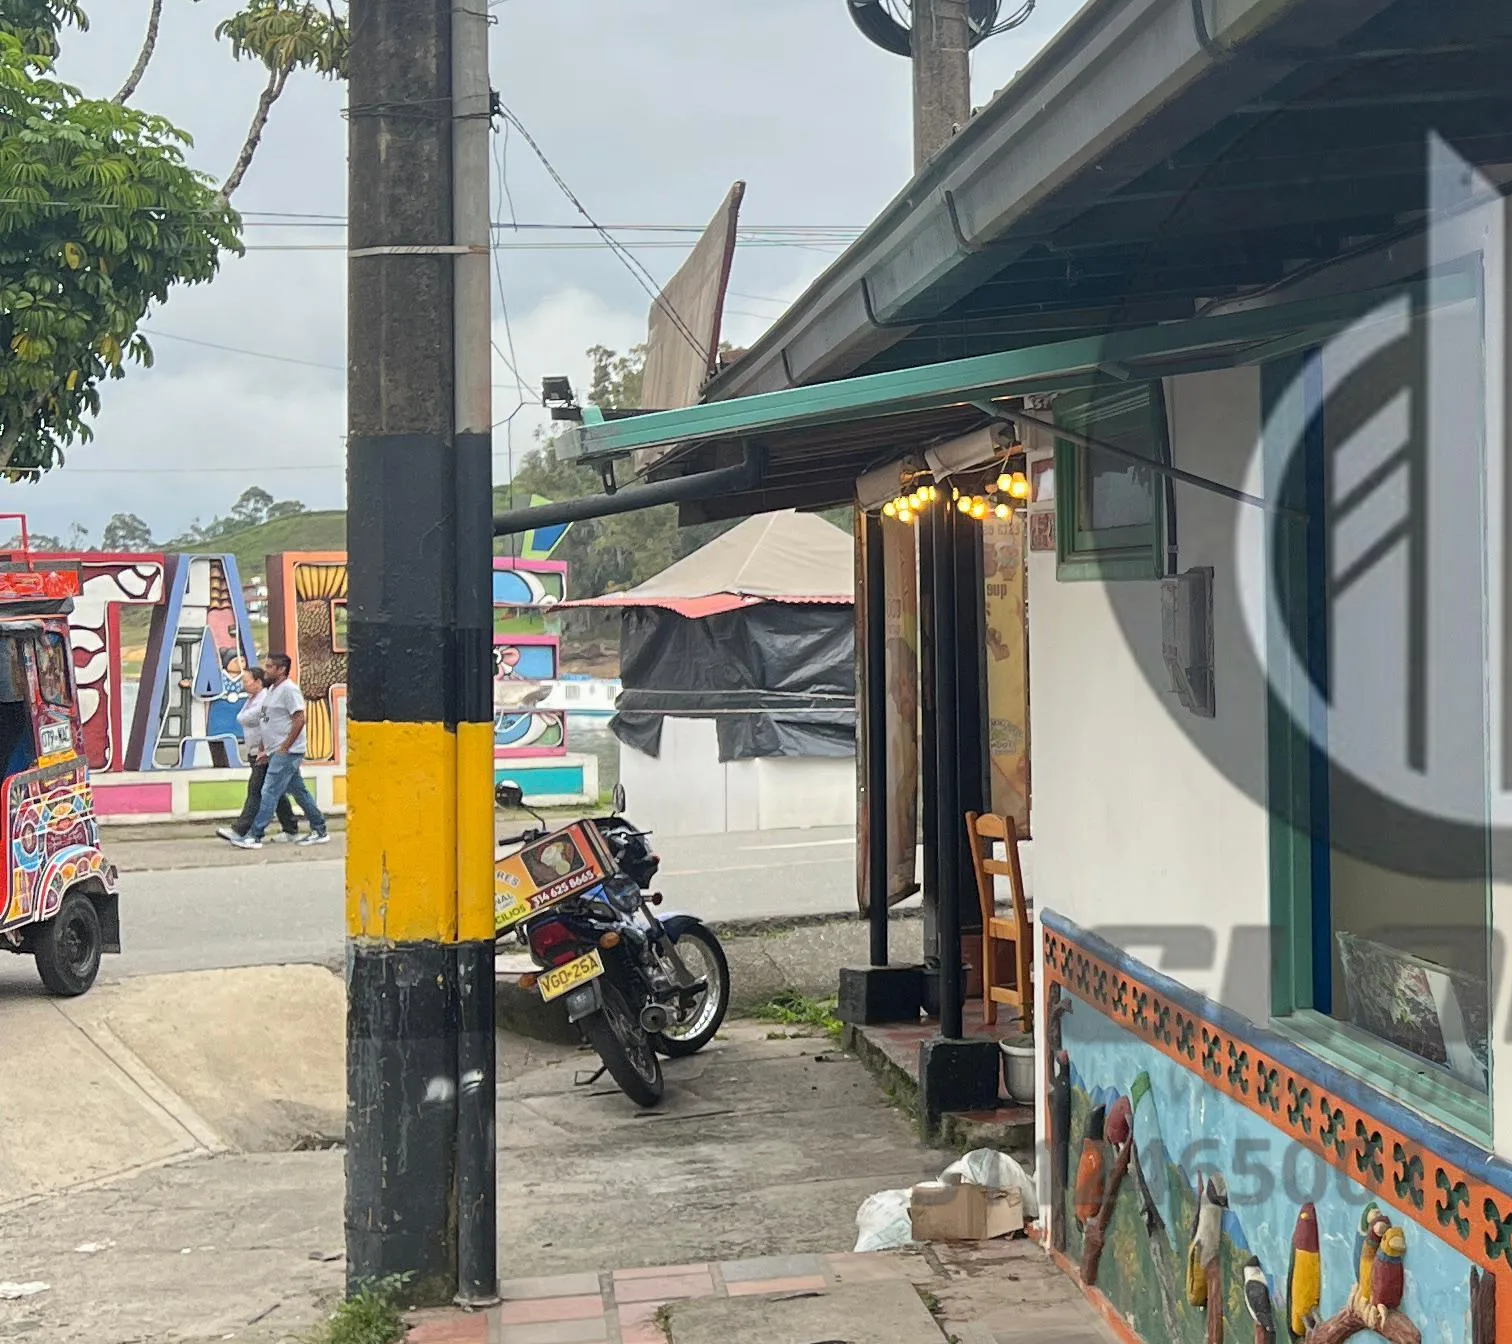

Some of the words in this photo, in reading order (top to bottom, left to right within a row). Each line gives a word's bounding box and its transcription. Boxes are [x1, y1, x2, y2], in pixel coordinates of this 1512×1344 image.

[531, 891, 550, 908] 314
[550, 881, 569, 897] 625
[568, 869, 594, 888] 8665
